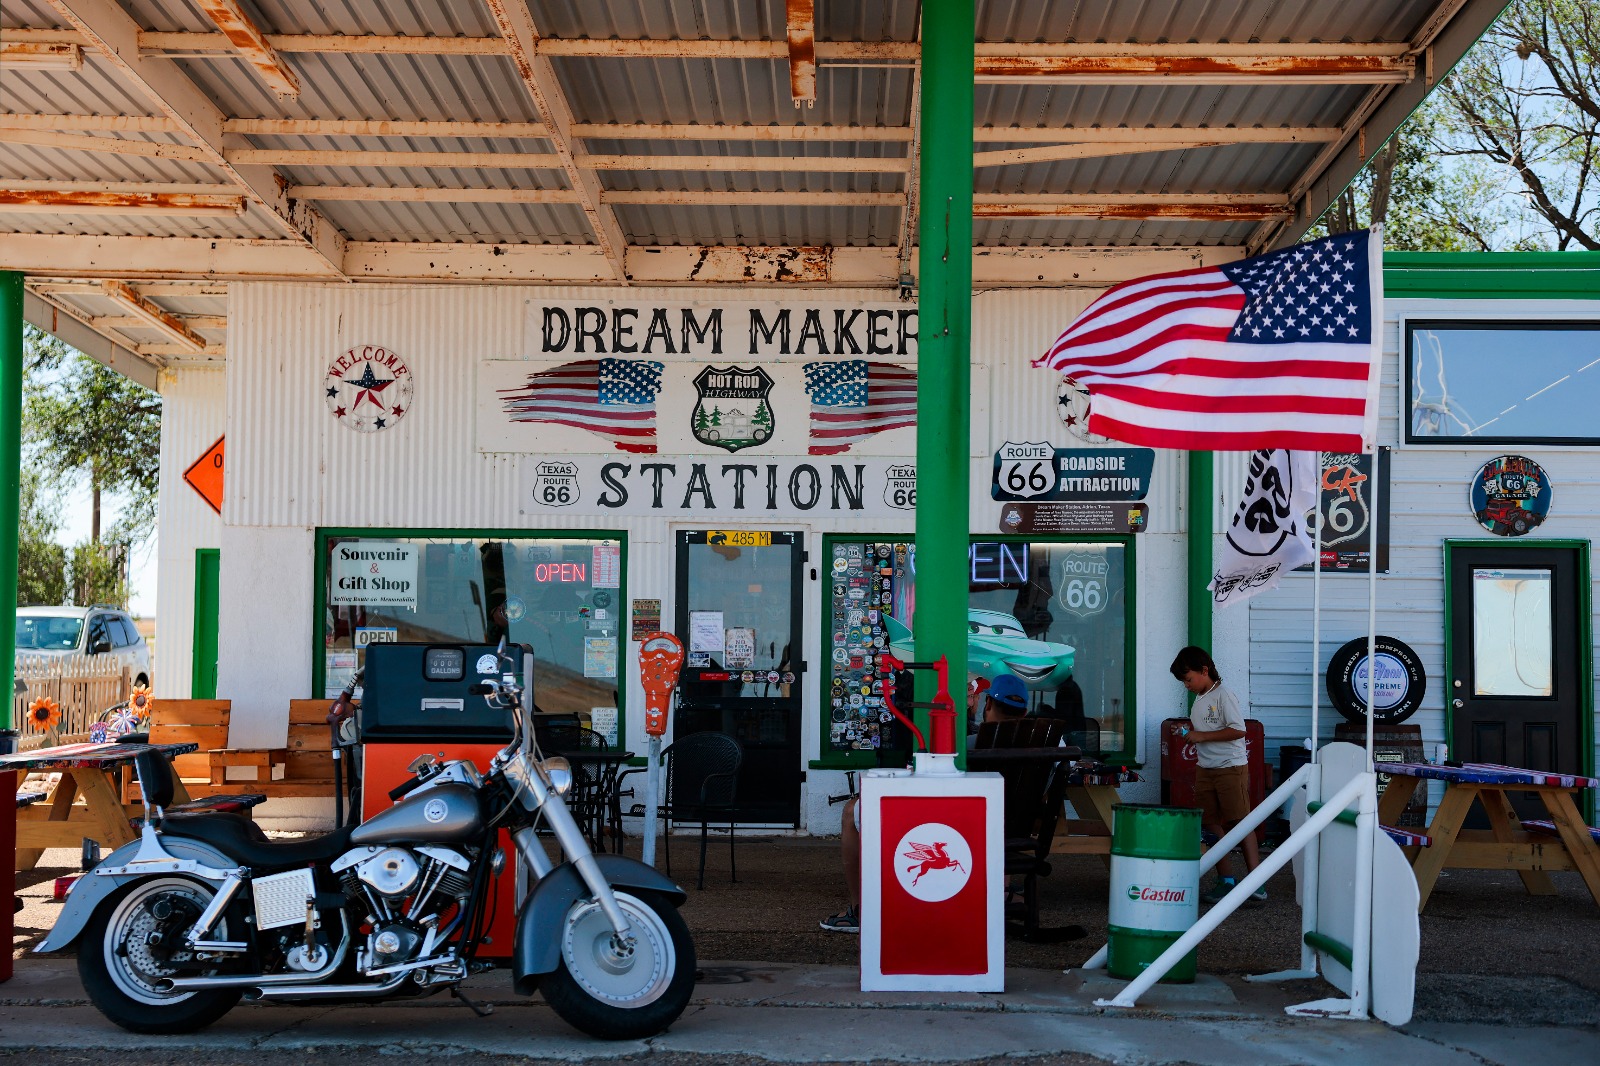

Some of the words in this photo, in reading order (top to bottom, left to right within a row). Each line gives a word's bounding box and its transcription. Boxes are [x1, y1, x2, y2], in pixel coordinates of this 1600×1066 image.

[540, 306, 723, 354] DREAM
[749, 307, 919, 355] MAKER
[329, 346, 408, 380] WELCOME
[708, 374, 732, 389] HOT
[734, 374, 760, 389] ROD
[705, 389, 763, 399] HIGHWAY
[1007, 448, 1047, 457] ROUTE
[541, 466, 572, 475] TEXAS
[1060, 457, 1126, 471] ROADSIDE
[892, 469, 916, 477] TEXA
[1007, 461, 1047, 491] 66
[543, 477, 571, 486] ROUTE
[596, 462, 867, 510] STATION
[1059, 477, 1140, 491] ATTRACTION
[1506, 480, 1521, 489] 66
[543, 486, 571, 503] 66
[732, 532, 755, 546] 485
[340, 547, 409, 561] Souvenir
[370, 562, 379, 574] &
[535, 563, 585, 582] OPEN
[1065, 560, 1106, 575] ROUTE
[338, 576, 367, 590] Gift
[371, 576, 410, 593] Shop
[1066, 579, 1101, 609] 66
[360, 631, 394, 644] OPEN
[1343, 651, 1360, 683] MICKEY
[1367, 644, 1412, 665] HOMPSON
[1363, 682, 1402, 690] SPREME
[1351, 701, 1386, 719] PRFILE
[1141, 887, 1186, 902] Castrol
